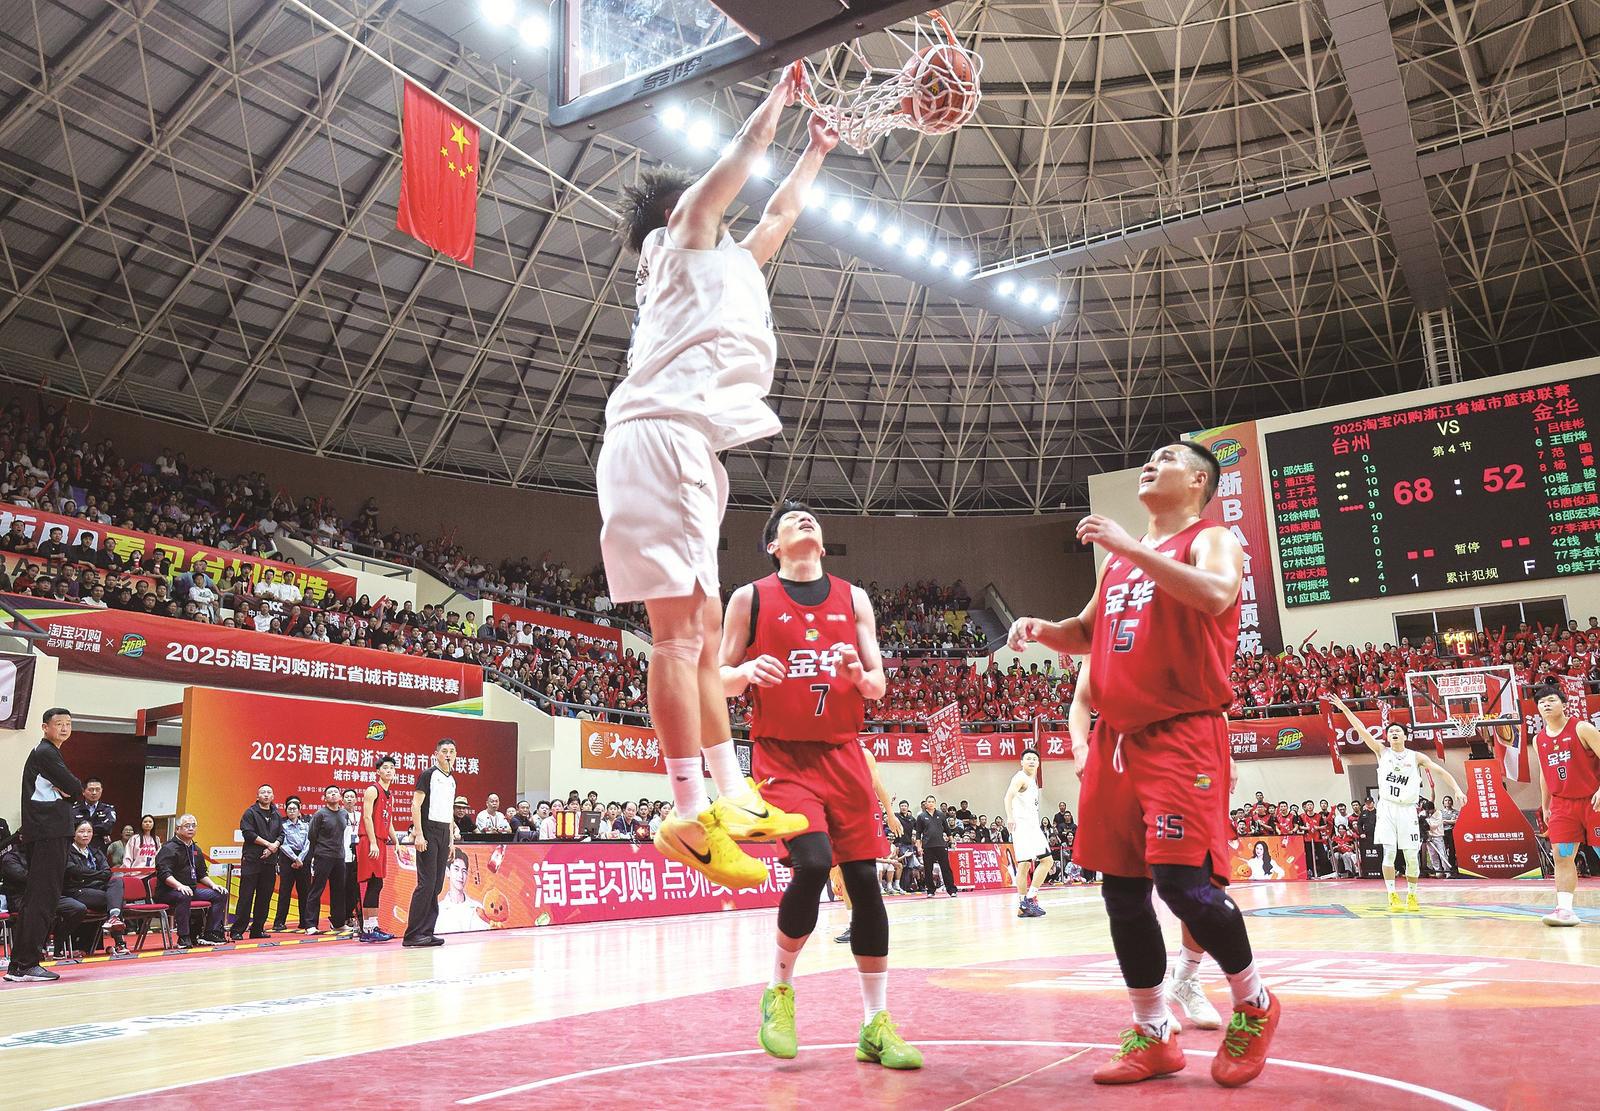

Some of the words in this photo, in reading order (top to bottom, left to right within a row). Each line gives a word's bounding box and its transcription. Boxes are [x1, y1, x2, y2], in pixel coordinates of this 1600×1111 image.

[1333, 384, 1571, 435] 2025淘宝闪购浙江省城市篮球联赛
[1532, 398, 1579, 421] 金华
[1437, 420, 1460, 435] VS
[1332, 433, 1371, 455] 台州
[1538, 451, 1544, 459] 7
[1364, 465, 1376, 474] 13
[1274, 492, 1280, 500] 8
[1366, 477, 1378, 486] 10
[1393, 478, 1433, 505] 68
[1482, 464, 1526, 492] 52
[1368, 489, 1380, 497] 18
[1371, 512, 1383, 520] 10
[1372, 525, 1378, 533] 2
[1373, 537, 1380, 545] 0
[1454, 541, 1480, 555] 暂停
[1375, 549, 1382, 557] 0
[1377, 561, 1383, 569] 2
[1378, 572, 1385, 580] 4
[1446, 567, 1498, 583] 累计犯规
[1104, 580, 1155, 616] 金华
[48, 623, 102, 643] 淘宝闪购
[1107, 619, 1139, 653] 15
[166, 642, 460, 696] 2025淘宝闪购浙江省城市篮球联赛
[810, 684, 830, 716] 7
[1548, 751, 1572, 766] 金华
[1386, 772, 1409, 786] 台州
[1558, 766, 1567, 780] 8
[1390, 786, 1400, 797] 10
[1156, 814, 1184, 840] 15
[532, 858, 657, 908] 淘宝闪购
